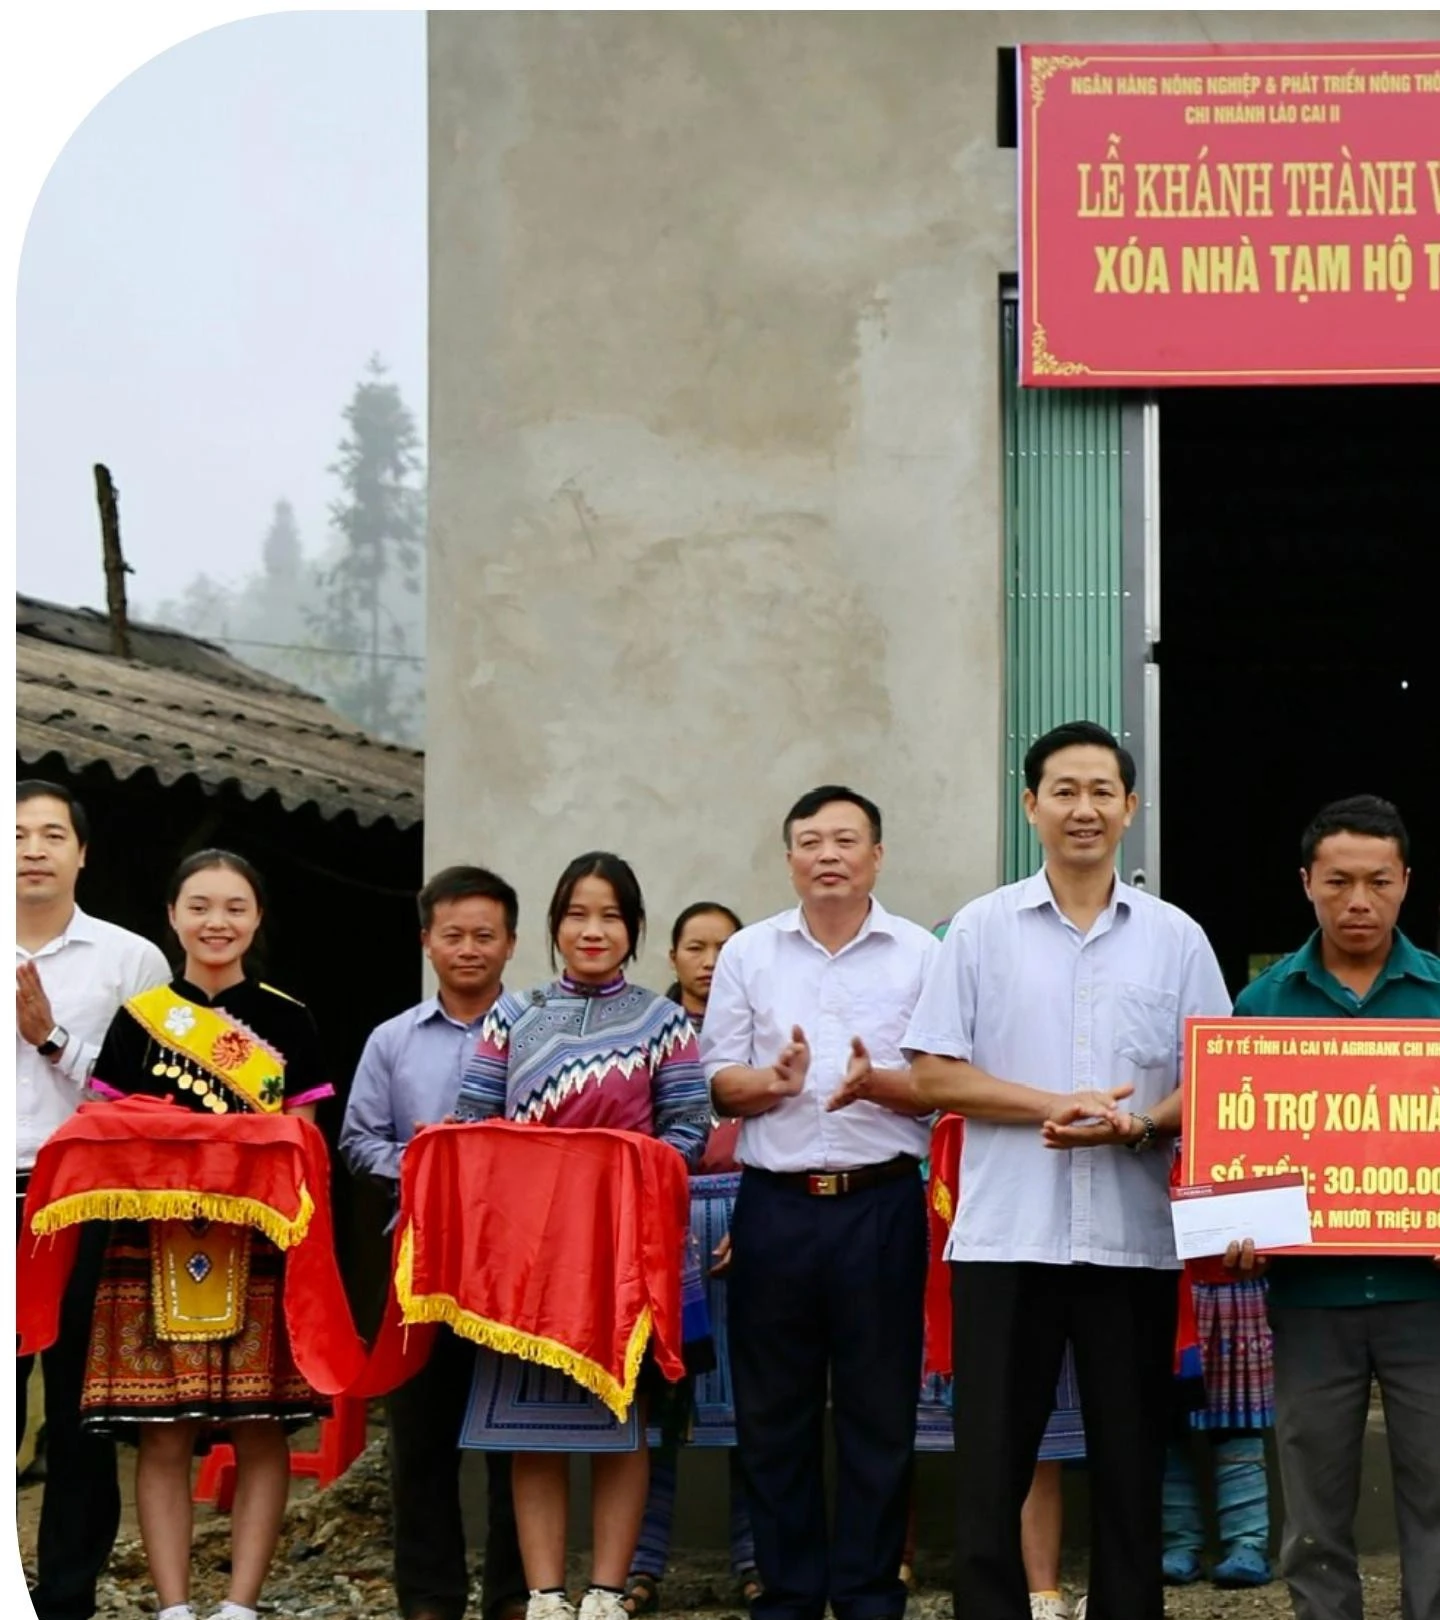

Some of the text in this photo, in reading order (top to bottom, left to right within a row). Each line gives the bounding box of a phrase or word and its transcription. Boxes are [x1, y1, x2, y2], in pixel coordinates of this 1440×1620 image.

[1071, 73, 1113, 96] NGÂN
[1117, 72, 1158, 96] HÀNG
[1161, 72, 1202, 96] NÔNG
[1207, 71, 1261, 98] NGHIỆP
[1265, 75, 1278, 95] &
[1280, 71, 1319, 95] PHÁT
[1369, 70, 1411, 93] NÔNG
[1184, 105, 1211, 124] CHI
[1213, 102, 1266, 124] NHÁNH
[1269, 102, 1298, 123] LÀO
[1300, 104, 1326, 123] CAI
[1077, 132, 1125, 218] LỄ
[1134, 145, 1274, 218] KHÁNH
[1282, 145, 1417, 217] THÀNH
[1094, 235, 1171, 294] XÓA
[1181, 234, 1261, 294] NHÀ
[1270, 243, 1352, 303] TẠM
[1363, 233, 1413, 302] HỘ
[1206, 1034, 1224, 1055] SỞ
[1227, 1040, 1235, 1055] Y
[1236, 1034, 1251, 1056] TẾ
[1253, 1035, 1280, 1056] TỈNH
[1283, 1036, 1298, 1057] LÀ
[1300, 1041, 1321, 1057] CAI
[1323, 1037, 1339, 1057] VÀ
[1341, 1041, 1401, 1057] AGRIBANK
[1403, 1041, 1424, 1057] CHI
[1218, 1076, 1256, 1132] HỖ
[1264, 1093, 1319, 1141] TRỢ
[1323, 1084, 1381, 1132] XOÁ
[1375, 1206, 1422, 1232] TRIỆU
